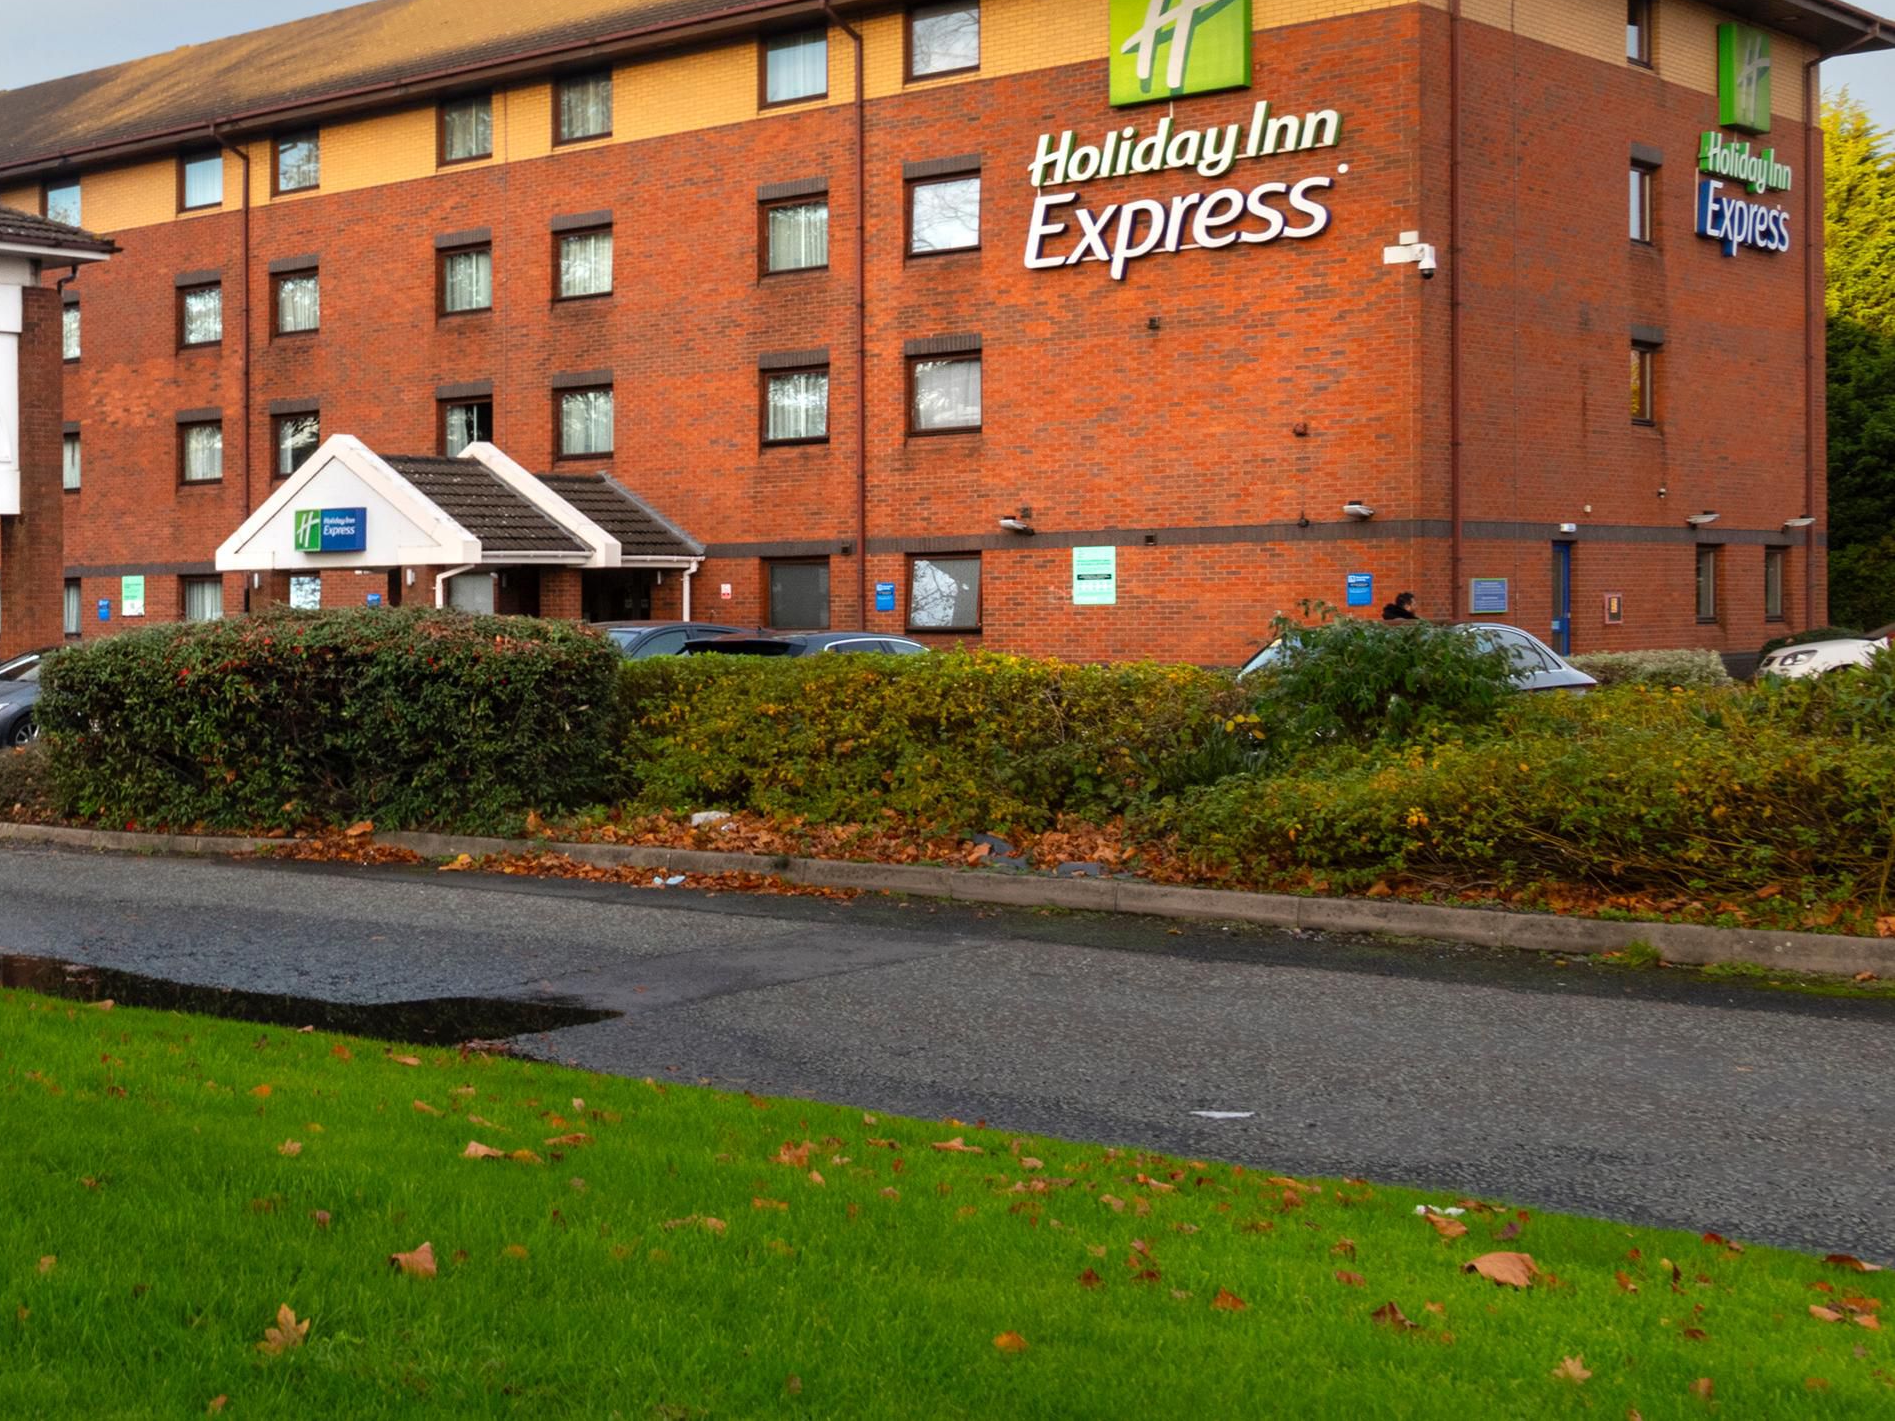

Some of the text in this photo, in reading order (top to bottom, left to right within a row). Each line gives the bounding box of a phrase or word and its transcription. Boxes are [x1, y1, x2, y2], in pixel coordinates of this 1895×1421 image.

[1028, 100, 1341, 186] Holiday Inn
[1708, 131, 1792, 194] Holiday Inn
[1024, 176, 1335, 281] Express
[1706, 179, 1790, 257] Express
[323, 525, 355, 537] Express
